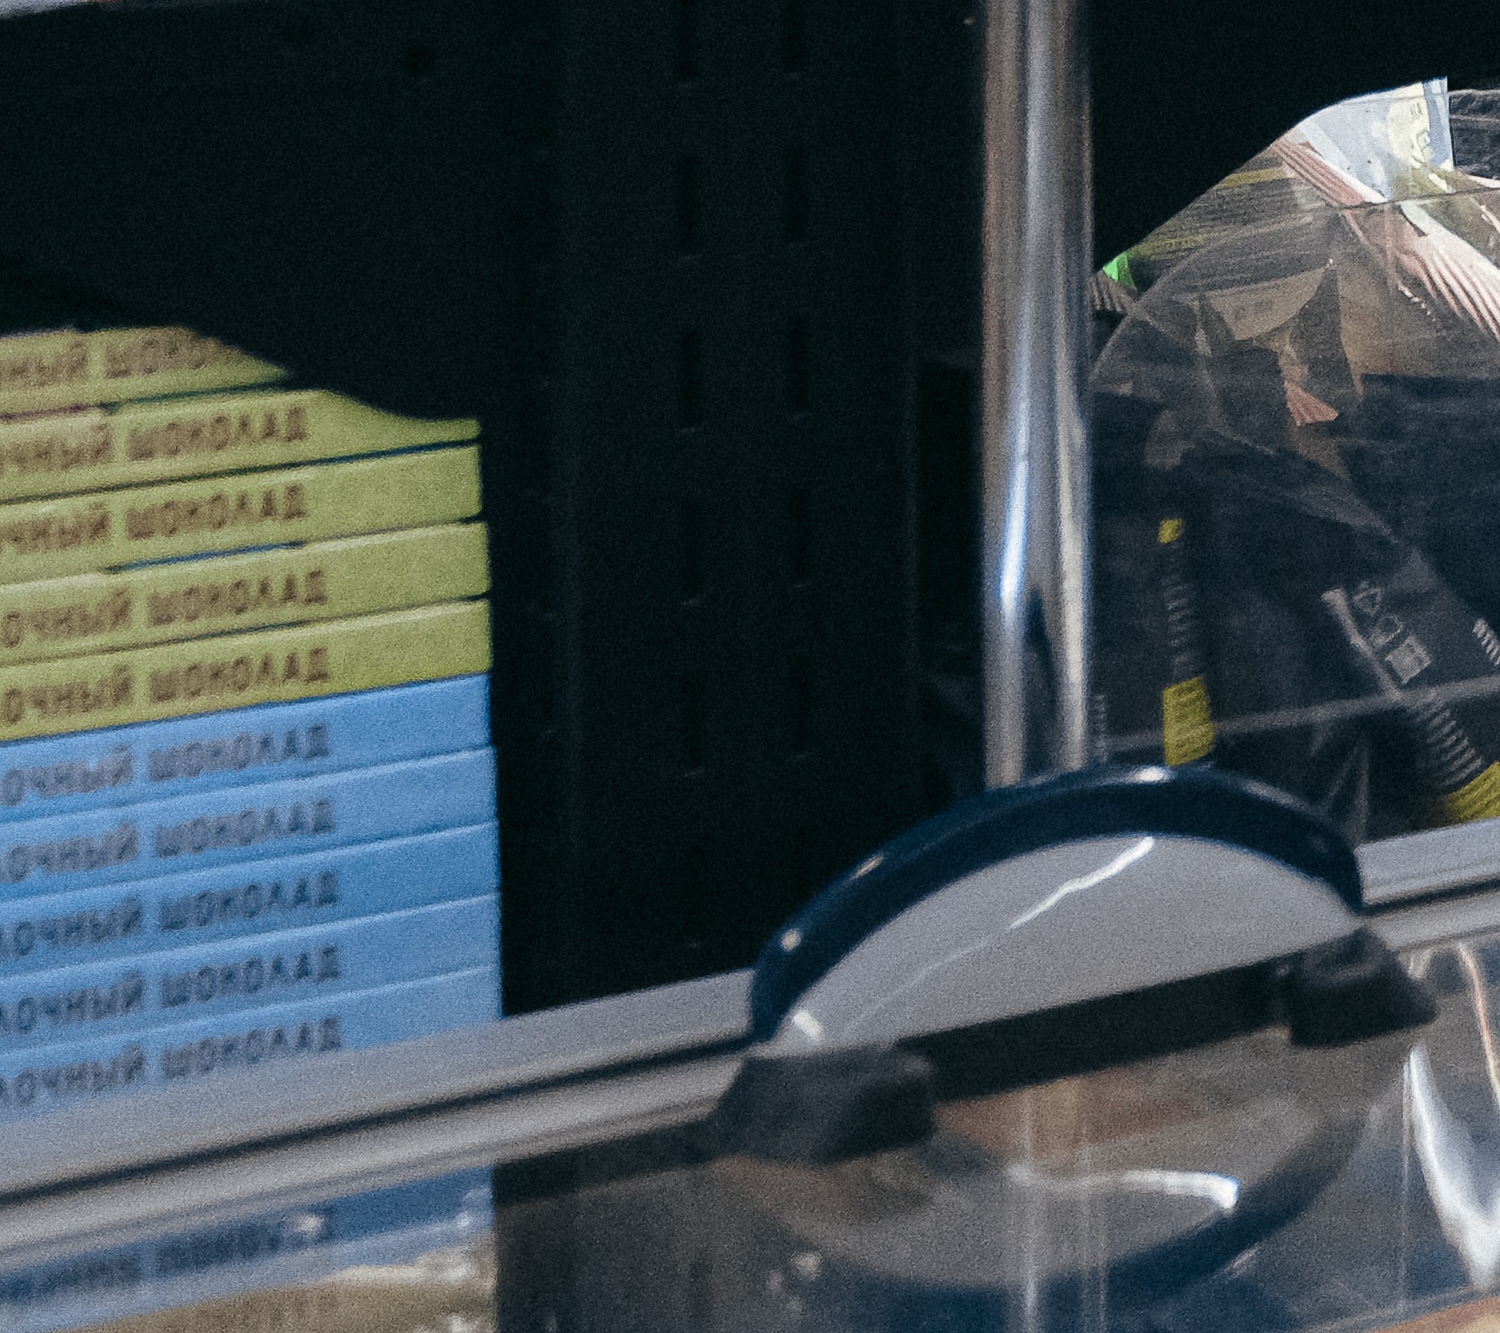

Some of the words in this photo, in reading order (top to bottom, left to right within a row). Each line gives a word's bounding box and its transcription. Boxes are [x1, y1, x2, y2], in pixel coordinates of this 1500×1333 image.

[147, 569, 329, 626] ШОКОЛАД
[149, 646, 331, 704] ШОКОЛАД
[149, 724, 331, 783] ШОКОЛАД
[154, 799, 337, 857] ШОКОЛАД
[158, 871, 341, 932] ШОКОЛАД
[161, 944, 341, 1006] ШОКОЛАД
[163, 1015, 343, 1080] ШОКОЛАД
